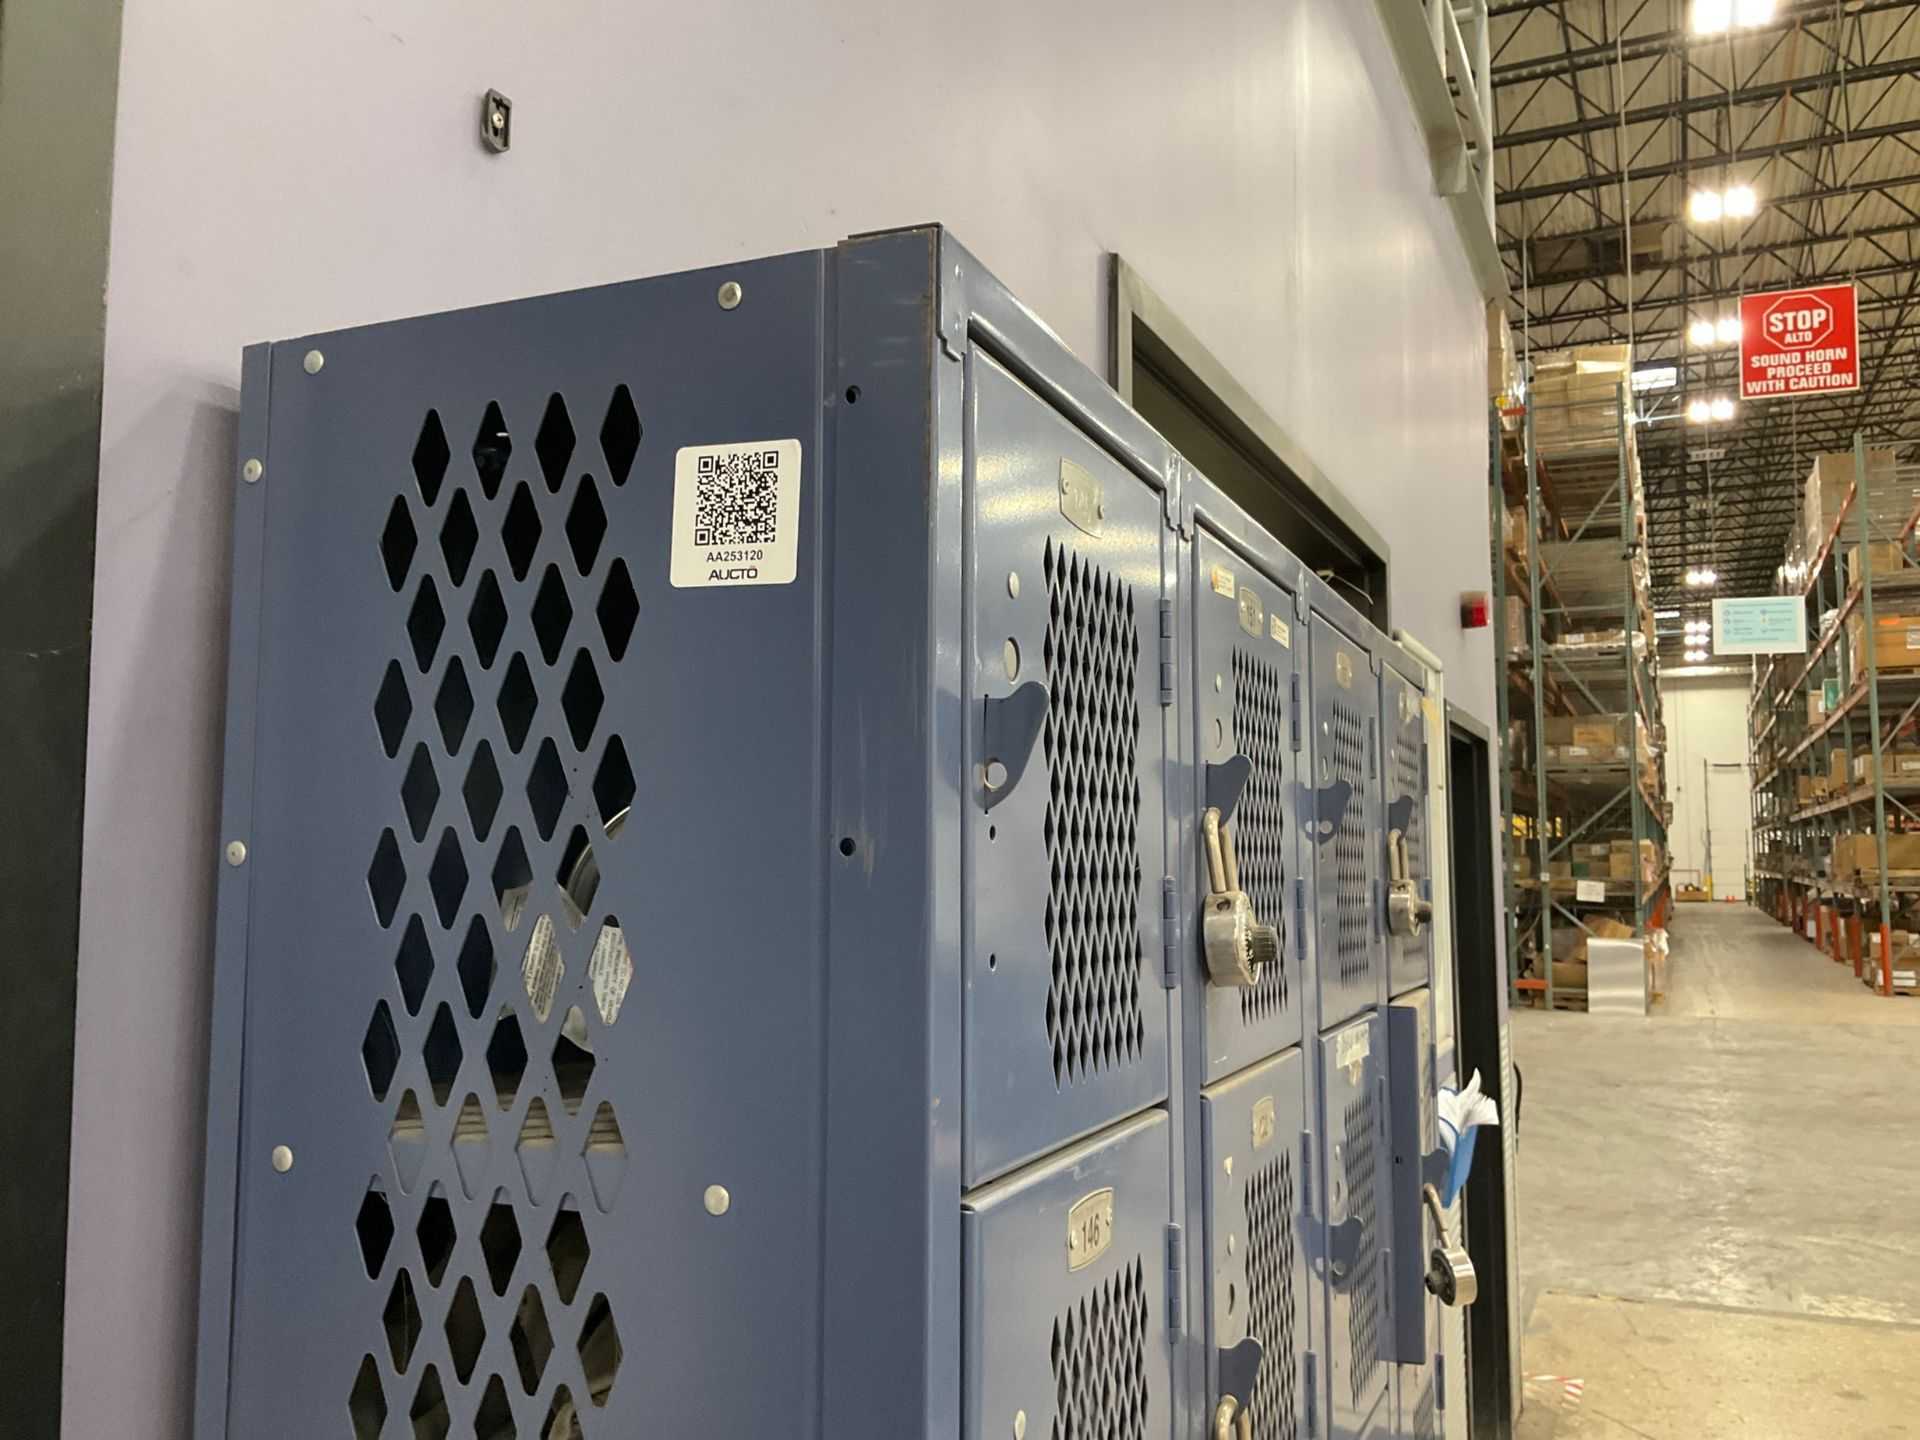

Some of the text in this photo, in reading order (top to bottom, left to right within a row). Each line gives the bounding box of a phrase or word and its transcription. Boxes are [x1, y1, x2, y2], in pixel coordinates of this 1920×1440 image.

[1769, 308, 1827, 333] STOP
[1784, 331, 1813, 344] ALTO
[1751, 347, 1848, 368] SOUND HORN
[1767, 362, 1832, 379] PROCEED
[1746, 373, 1853, 394] WITH CAUTION
[706, 550, 763, 562] AA253120
[708, 567, 758, 581] AUCTO
[1082, 1213, 1100, 1253] 146
